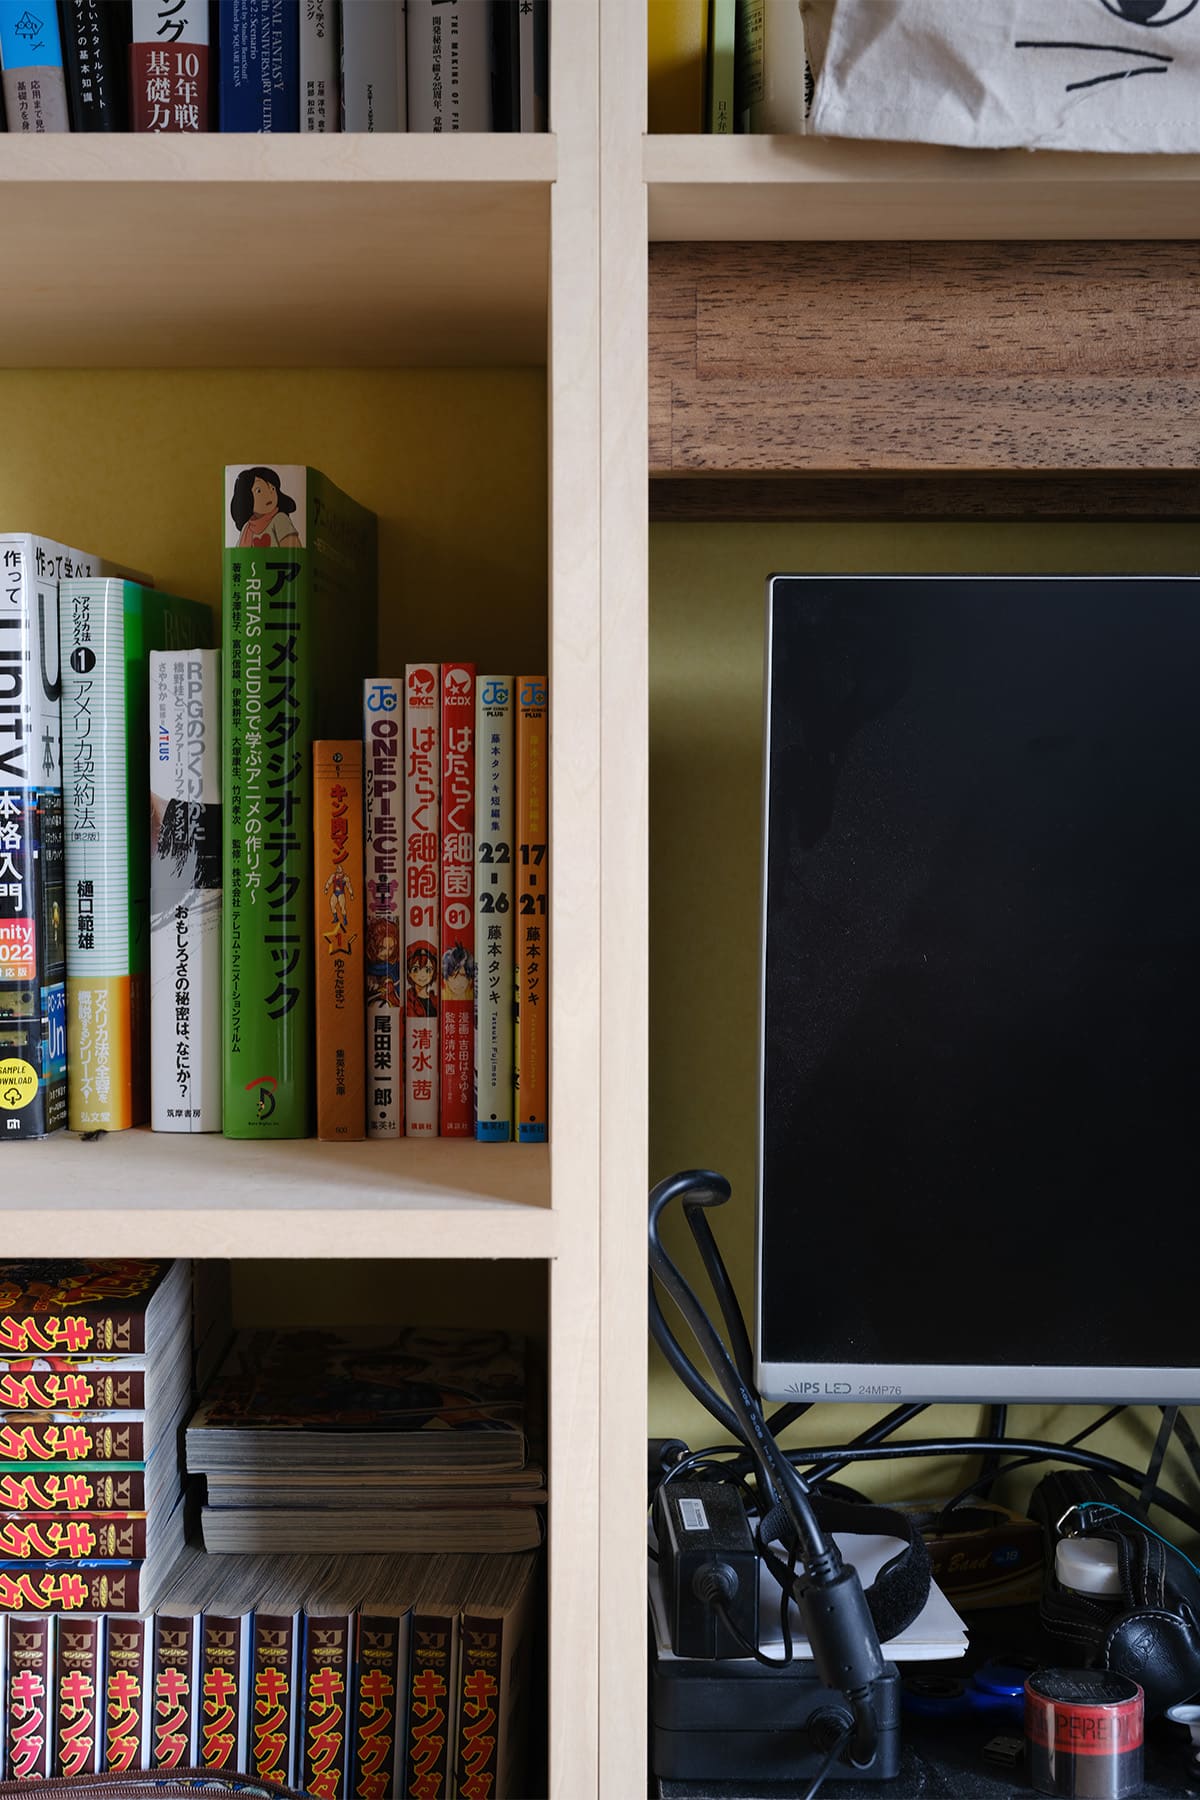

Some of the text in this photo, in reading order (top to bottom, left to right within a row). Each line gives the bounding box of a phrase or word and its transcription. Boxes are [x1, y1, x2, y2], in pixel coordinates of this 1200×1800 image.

[250, 19, 259, 60] Scenario
[450, 15, 459, 35] THE
[261, 14, 272, 94] ANNIVERSARY
[271, 31, 285, 91] FANTASY
[451, 42, 459, 85] MAKING
[17, 81, 30, 133] 基礎力を身
[146, 51, 171, 133] 基礎力
[175, 53, 200, 133] 10年戦
[452, 92, 459, 105] OF
[72, 596, 83, 646] ベーシックス
[81, 596, 92, 642] アメリカ法
[158, 662, 170, 763] さやわか ATLUS
[445, 695, 472, 706] KCDX
[73, 680, 97, 831] アメリカ契約法
[187, 661, 206, 843] RPGのつくりかた
[263, 561, 302, 1022] アニメスタジオテクニック
[371, 719, 398, 874] ONE PIECE
[490, 734, 501, 832] 藤本タツキ短編集
[366, 769, 378, 844] ワンピース
[407, 726, 437, 900] はたらく細胞
[443, 726, 474, 900] はたらく細菌
[329, 782, 349, 866] キン肉マン
[0, 790, 24, 913] 本格入門
[478, 843, 511, 865] 22
[519, 844, 546, 867] 17
[77, 880, 96, 950] 樋口範雄
[479, 892, 511, 914] 26
[520, 894, 546, 915] 21
[0, 926, 33, 944] nity
[410, 910, 434, 933] 01
[448, 909, 467, 930] 01
[0, 943, 34, 961] 022
[487, 925, 503, 1005] 藤本タツキ
[526, 926, 541, 1007] 藤本タツキ
[334, 958, 345, 1010] ゆでたまご
[174, 904, 192, 1098] おもしろさの秘密は、なにか？
[335, 1048, 346, 1097] 集英社文庫
[373, 1015, 393, 1106] 尾田栄一郎
[81, 1111, 111, 1123] 弘文堂
[167, 1107, 201, 1120] 筑摩書房
[96, 1319, 106, 1351] YJC
[114, 1317, 131, 1352] YJ
[96, 1377, 106, 1407] YJC
[114, 1375, 131, 1409] YJ
[799, 1381, 902, 1396] IPS LED 24MP76
[95, 1427, 105, 1458] YJC
[113, 1426, 130, 1459] YJ
[96, 1477, 106, 1508] YJC
[114, 1475, 131, 1508] YJ
[99, 1525, 109, 1556] YJC
[117, 1523, 134, 1556] YJ
[91, 1576, 101, 1608] YJC
[109, 1574, 126, 1609] YJ
[13, 1632, 44, 1651] YJ
[63, 1632, 93, 1651] YJ
[110, 1632, 141, 1651] YJ
[159, 1630, 190, 1649] YJ
[205, 1630, 236, 1648] YJ
[257, 1630, 289, 1648] YJ
[312, 1630, 343, 1647] YJ
[362, 1632, 394, 1650] YJ
[415, 1632, 448, 1650] YJ
[467, 1632, 498, 1650] YJ
[14, 1659, 44, 1668] YJC
[63, 1660, 94, 1669] YJC
[110, 1660, 141, 1668] YJC
[159, 1657, 189, 1666] YJC
[206, 1656, 236, 1665] YJC
[257, 1656, 289, 1665] YJC
[312, 1656, 344, 1665] YJC
[10, 1669, 46, 1780] キング
[253, 1667, 289, 1786] キング
